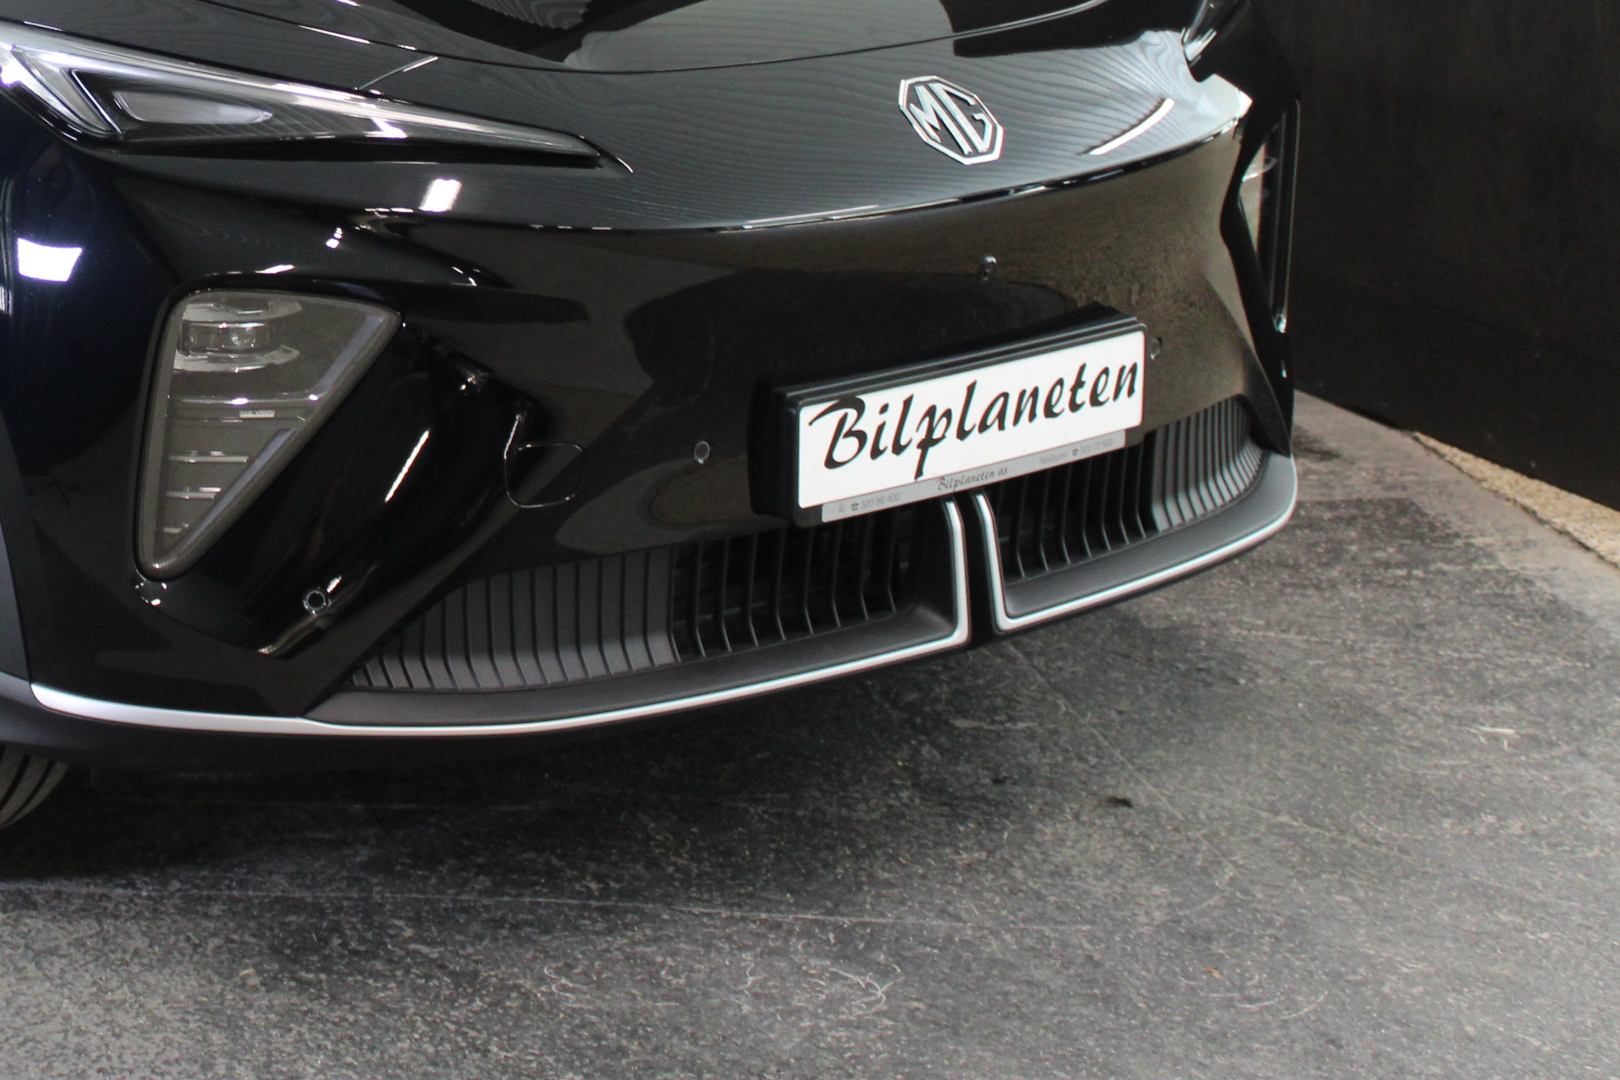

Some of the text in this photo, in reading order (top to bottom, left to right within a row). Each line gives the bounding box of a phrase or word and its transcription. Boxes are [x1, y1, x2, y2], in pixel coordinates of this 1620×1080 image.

[908, 82, 993, 156] MG
[808, 361, 1138, 481] Bilplaneten
[937, 469, 996, 492] Bilplaneten
